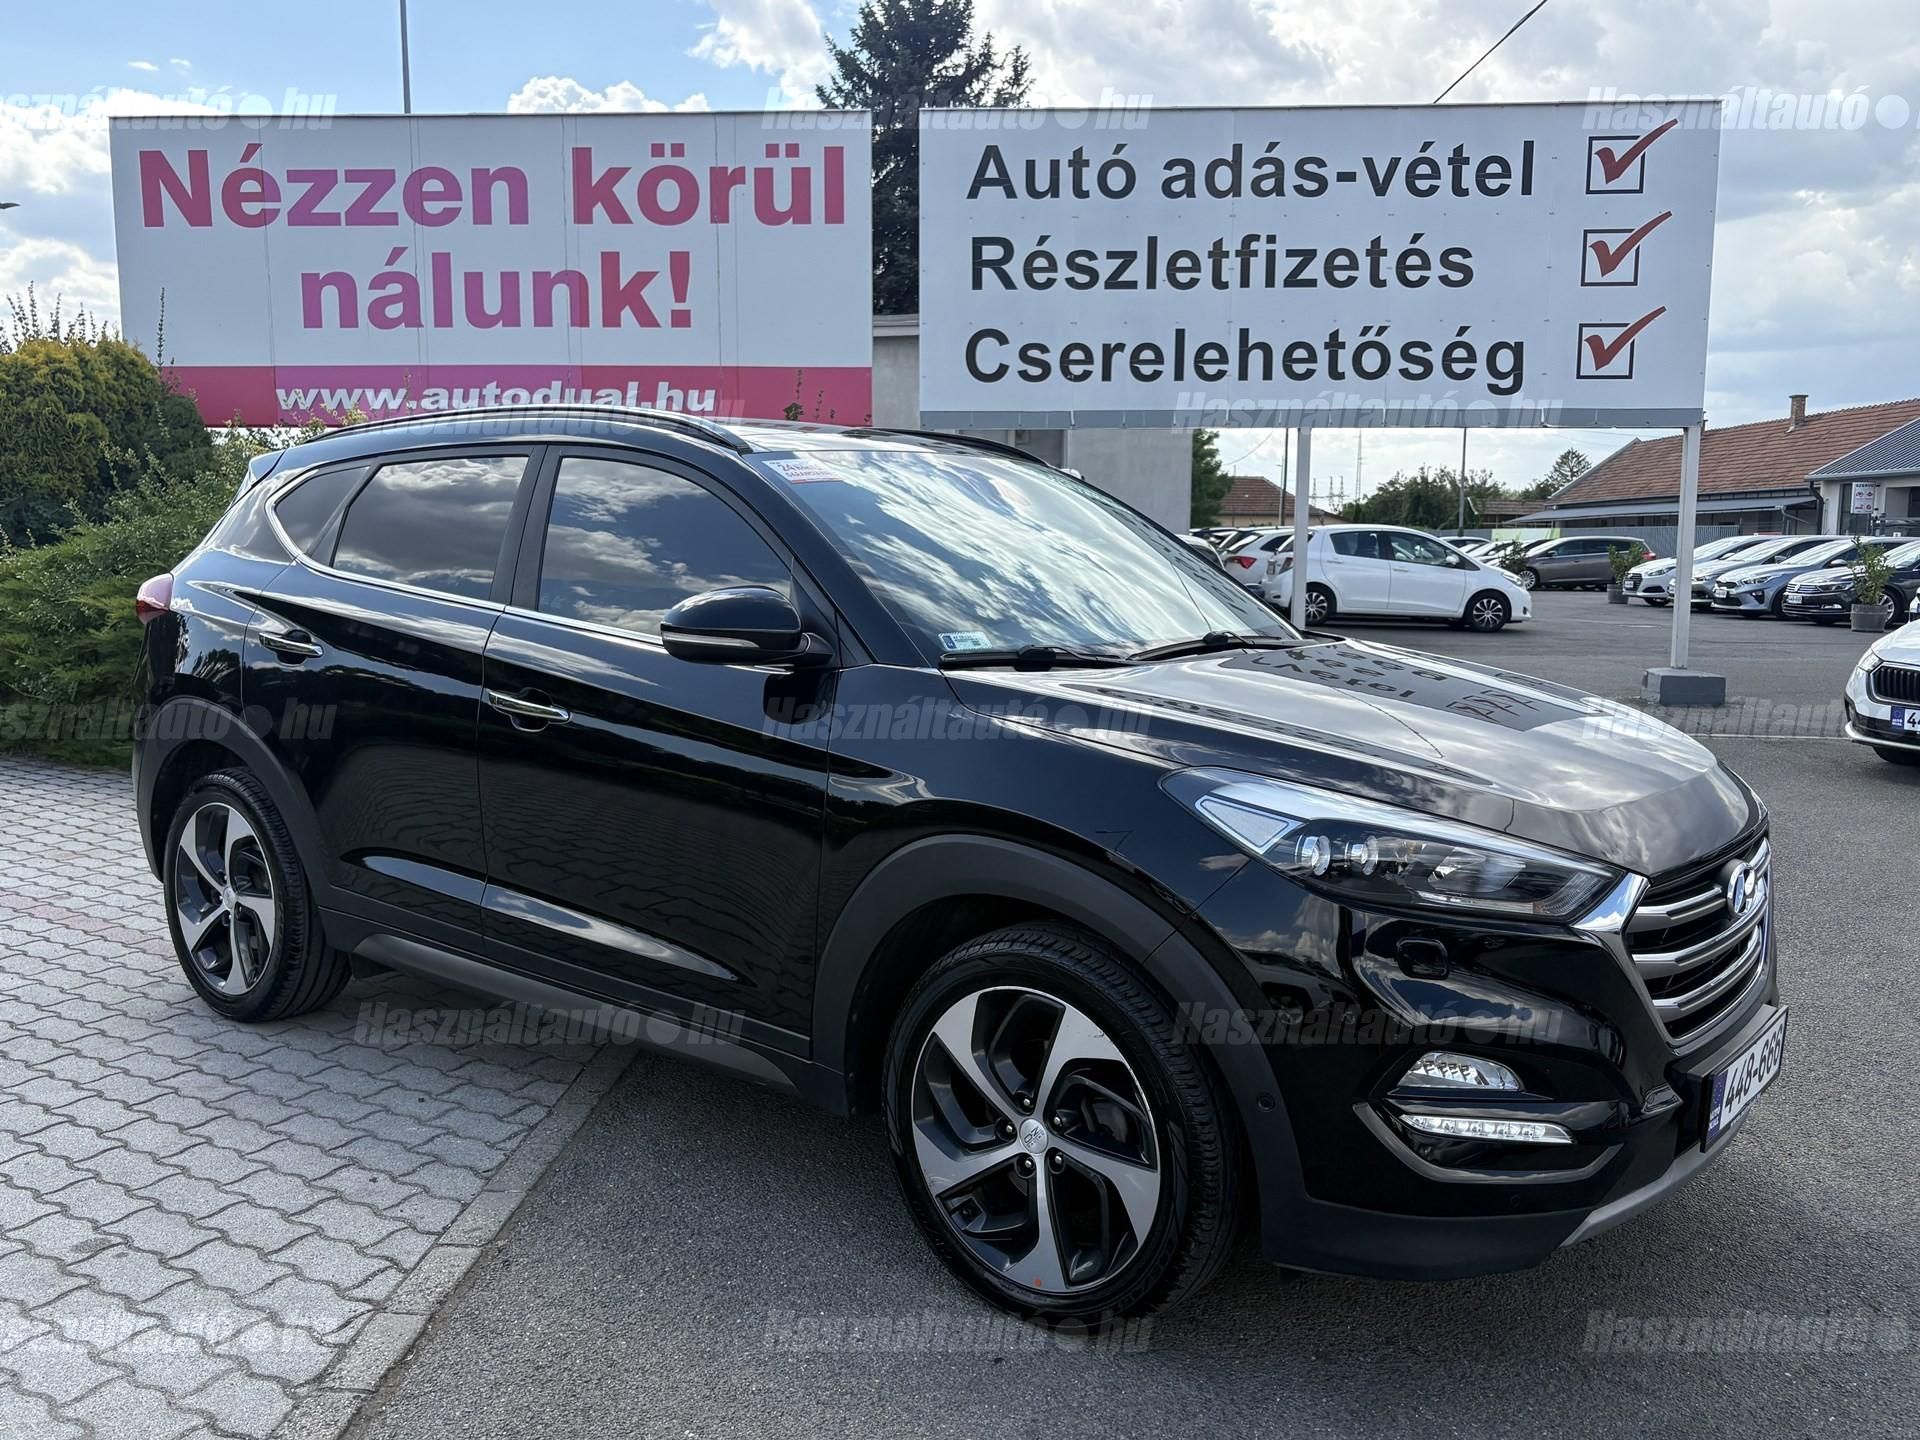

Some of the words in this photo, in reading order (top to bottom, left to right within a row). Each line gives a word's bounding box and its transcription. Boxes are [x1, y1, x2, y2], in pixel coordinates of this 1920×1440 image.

[139, 143, 530, 228] Nézzen
[573, 143, 845, 226] körül
[967, 143, 1137, 200] Autó
[1161, 140, 1534, 198] adás-vétel
[301, 247, 693, 330] nálunk!
[971, 233, 1475, 291] Részletfizetés
[965, 323, 1527, 395] Cserelehetőség
[276, 381, 716, 412] www.autodual.hu
[1725, 1023, 1782, 1113] 448-666
